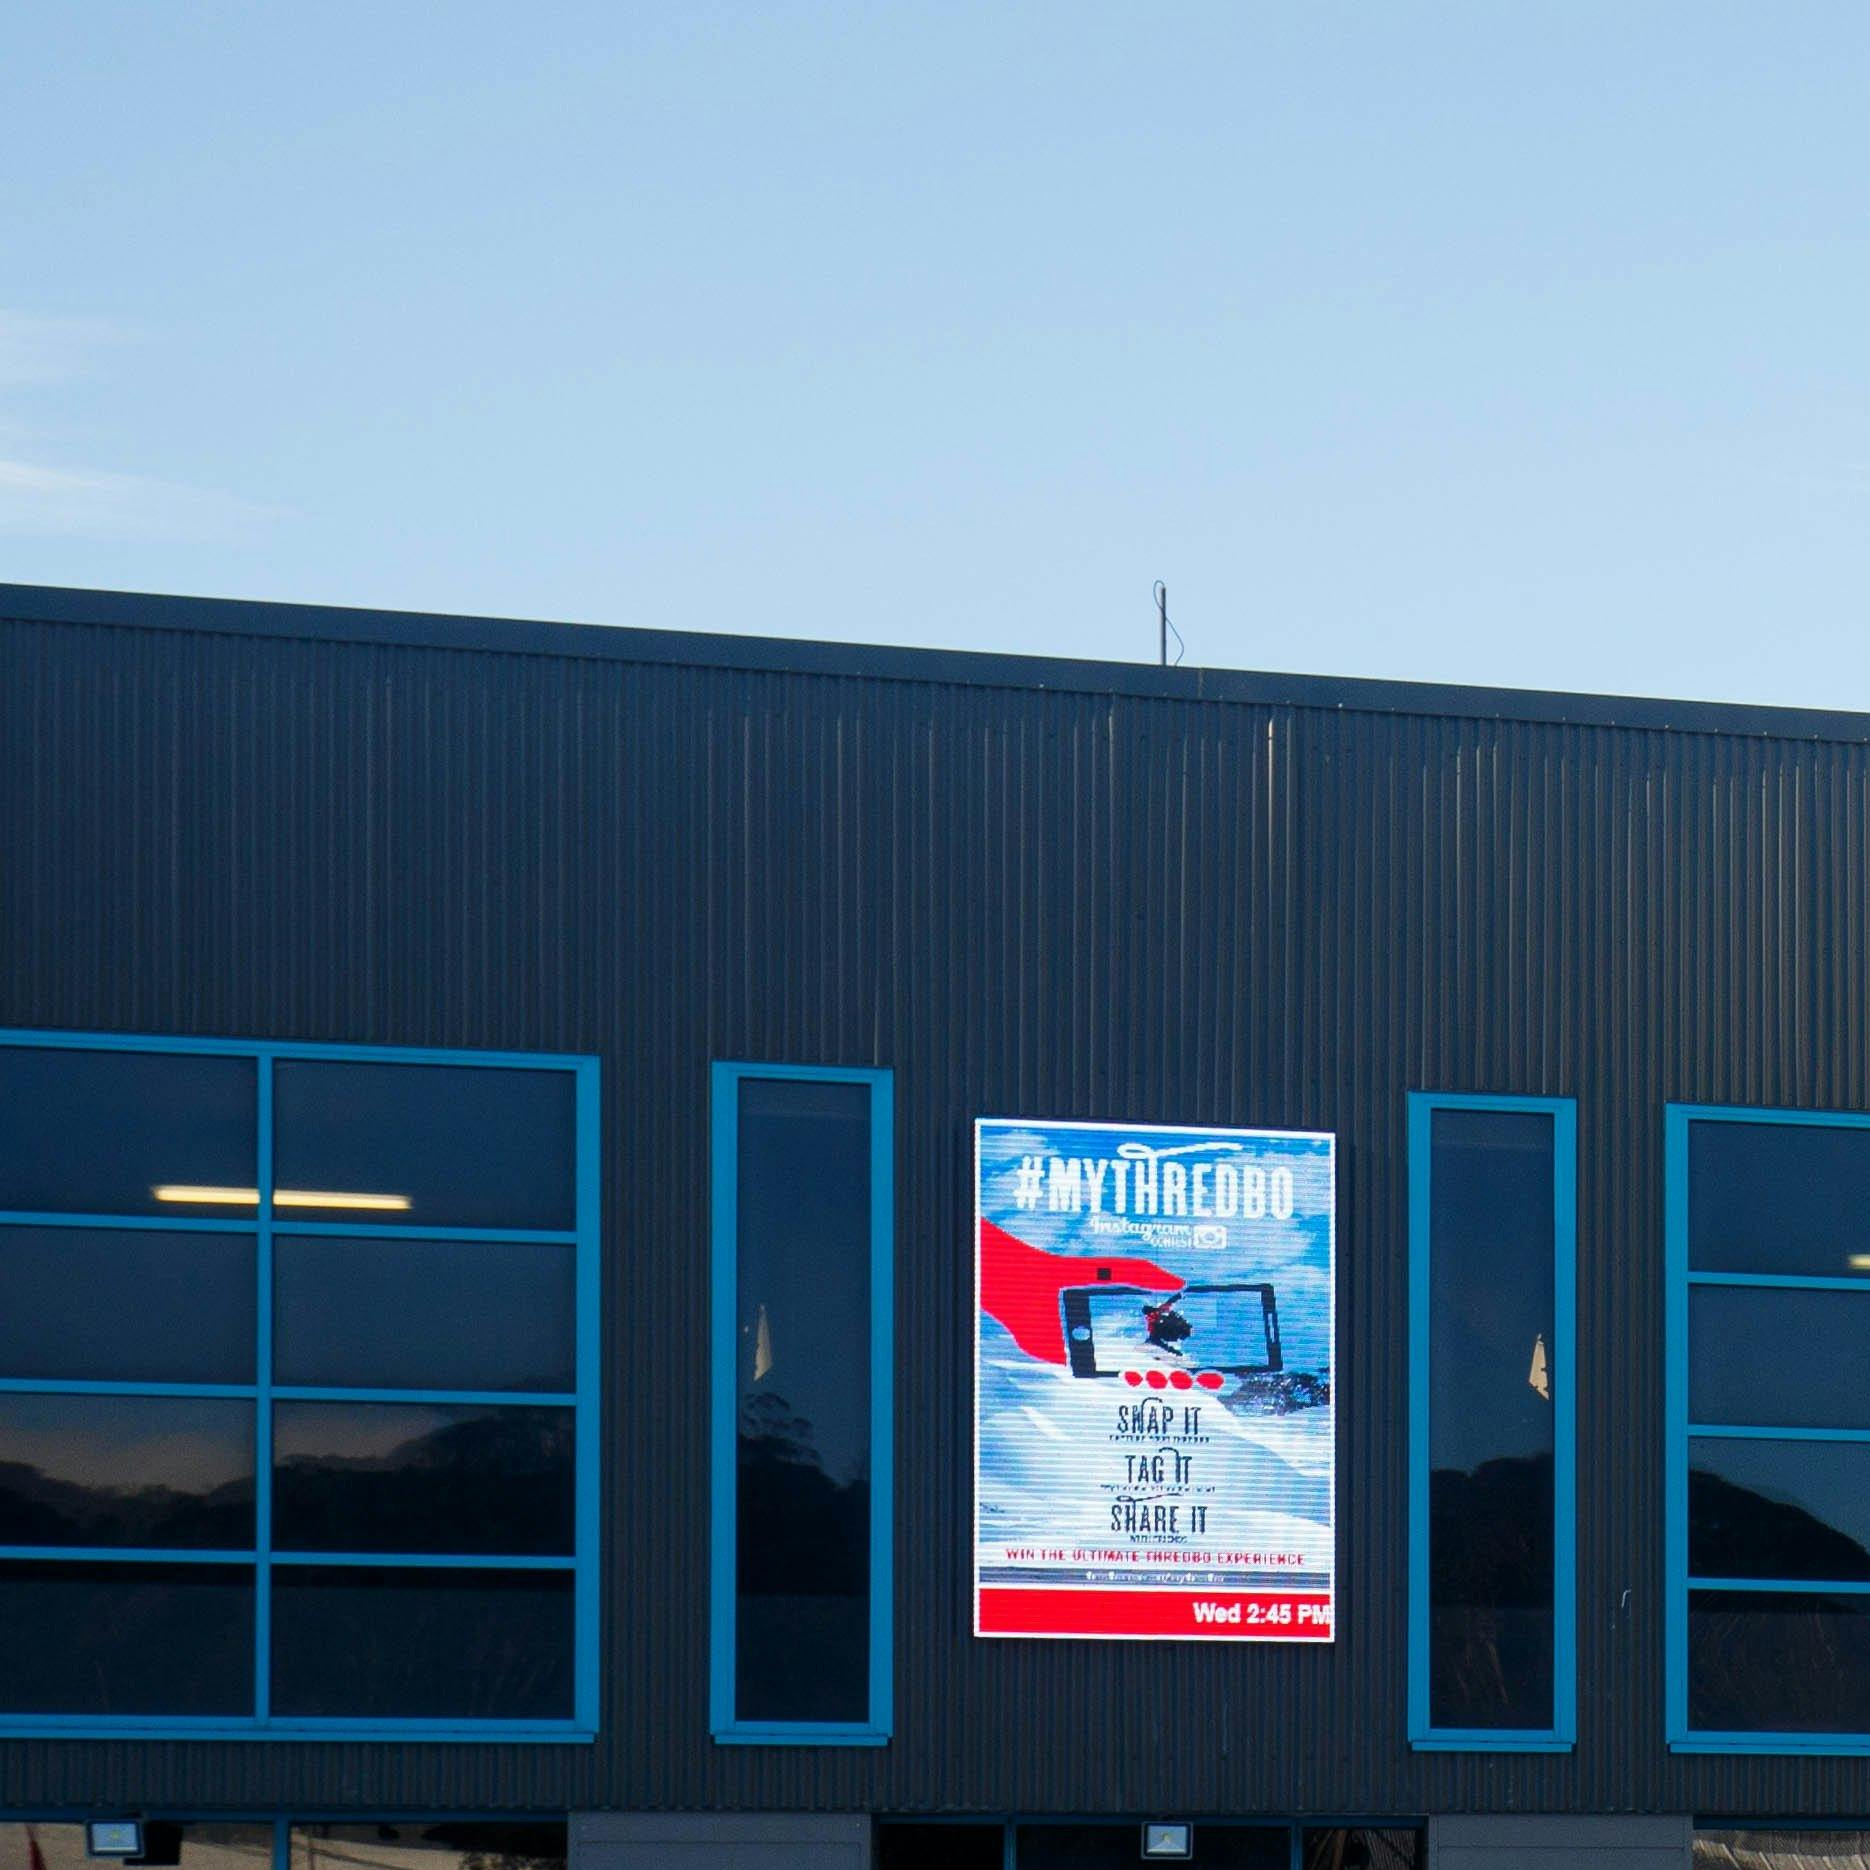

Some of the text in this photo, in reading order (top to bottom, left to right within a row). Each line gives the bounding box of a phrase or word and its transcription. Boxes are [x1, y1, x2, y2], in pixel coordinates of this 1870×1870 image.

[1013, 1145, 1294, 1219] #MYTHREDBO
[1091, 1216, 1191, 1242] Instagram
[1117, 1398, 1202, 1435] SNAP IT
[1125, 1449, 1193, 1485] TAG IT
[1111, 1495, 1208, 1534] SHARE IT
[1006, 1548, 1305, 1565] WIN THE ULTIMATE THREDBO EXPERIENCE
[1192, 1602, 1332, 1625] Wed 2:45 PM
